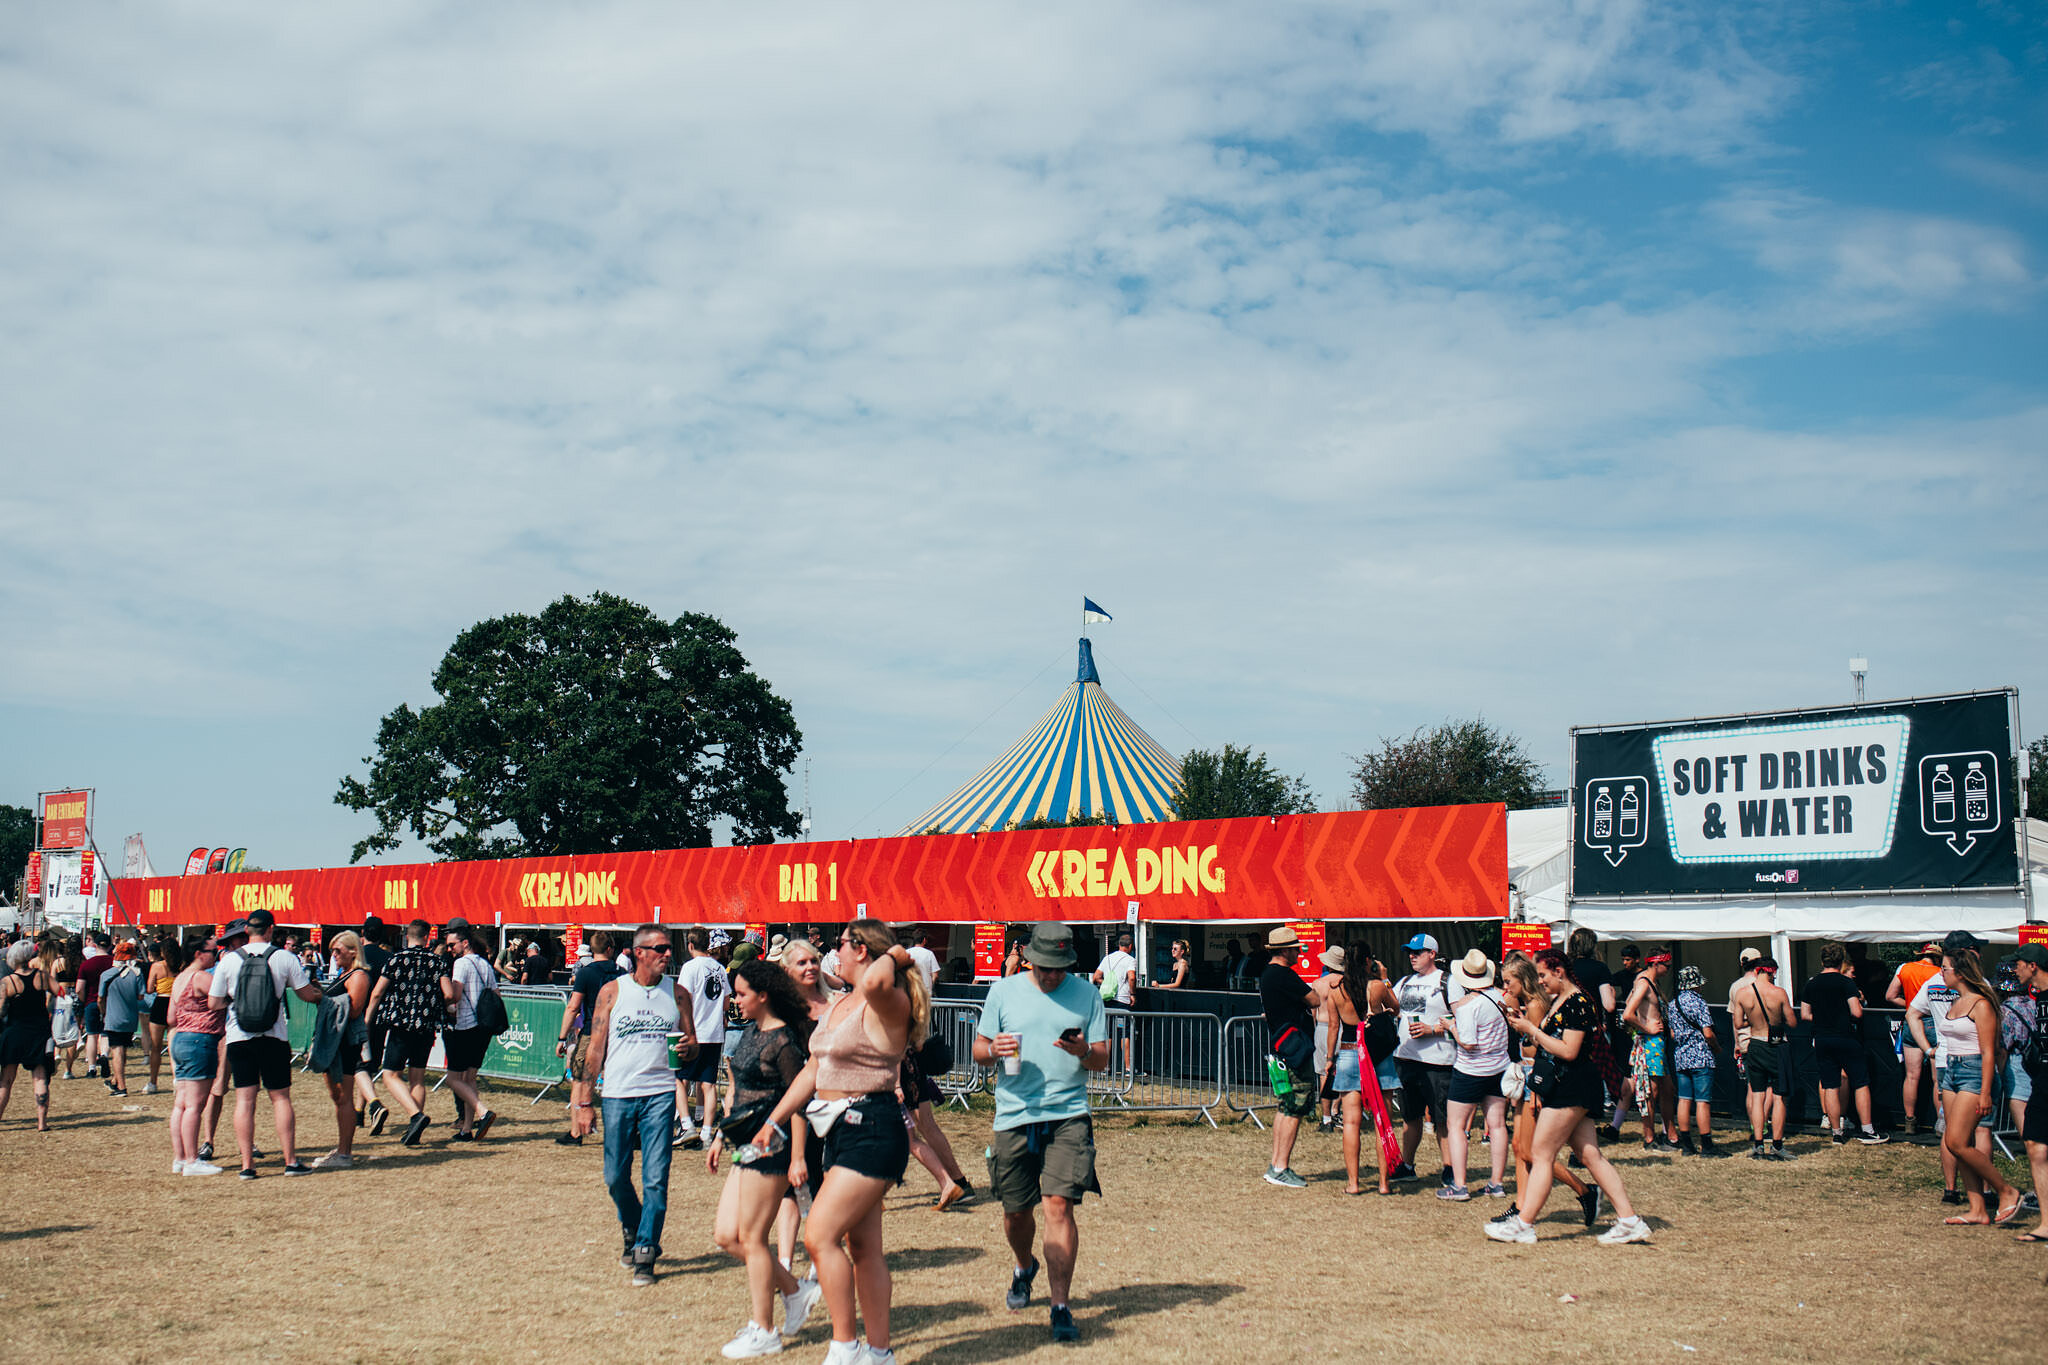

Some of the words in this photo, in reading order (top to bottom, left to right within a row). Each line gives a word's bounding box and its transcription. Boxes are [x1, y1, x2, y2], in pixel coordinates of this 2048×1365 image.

[1673, 755, 1747, 796] SOFT
[1760, 744, 1887, 790] DRINKS
[1703, 802, 1727, 839] &
[1738, 795, 1853, 837] WATER
[538, 871, 619, 908] READING
[779, 863, 818, 902] BAR
[828, 862, 837, 901] 1
[1062, 844, 1226, 897] READING
[149, 889, 164, 912] BAR
[167, 888, 171, 912] 1
[244, 883, 294, 912] READING
[384, 879, 407, 909] BAR
[412, 879, 418, 909] 1
